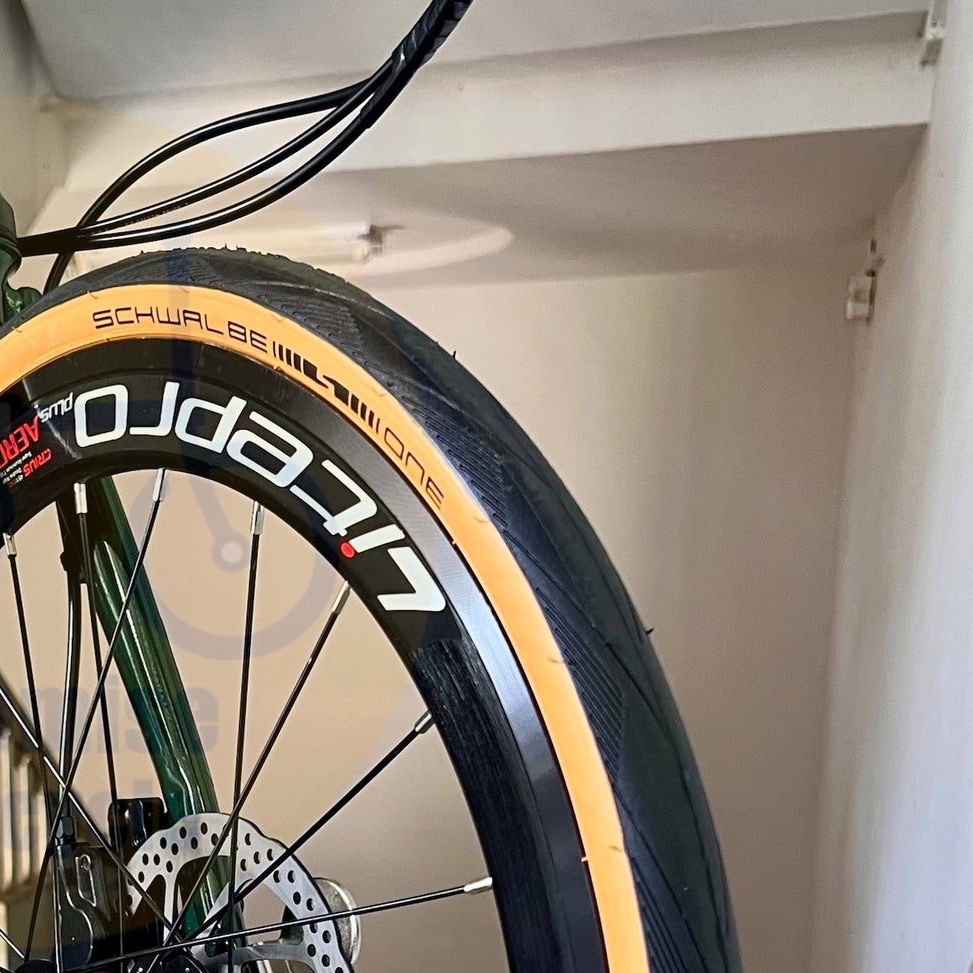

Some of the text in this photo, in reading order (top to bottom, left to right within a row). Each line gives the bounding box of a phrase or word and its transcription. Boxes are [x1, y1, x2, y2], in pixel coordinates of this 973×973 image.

[23, 448, 52, 477] CRIUS
[92, 305, 445, 508] SCHWALBE ONE
